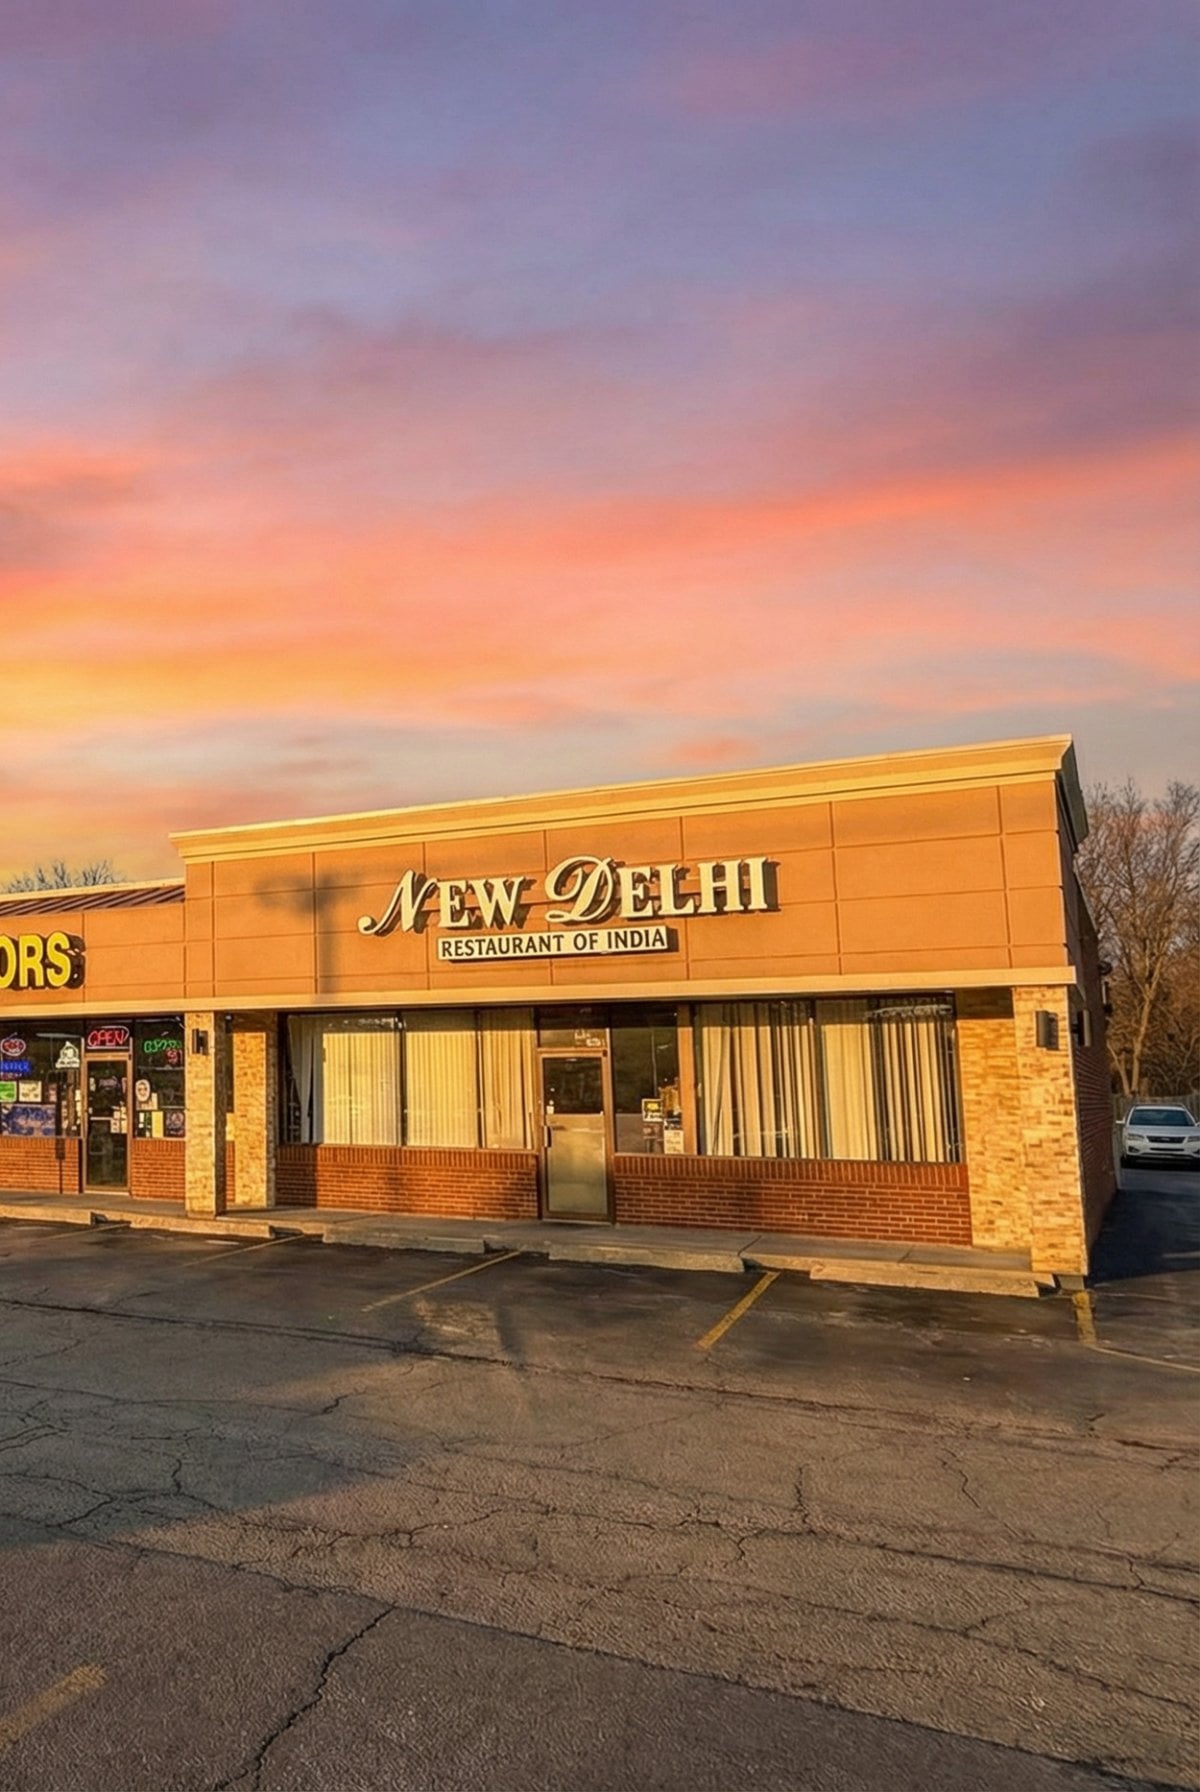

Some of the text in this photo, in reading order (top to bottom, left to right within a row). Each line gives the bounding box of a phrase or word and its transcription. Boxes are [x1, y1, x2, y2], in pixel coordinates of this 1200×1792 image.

[357, 855, 769, 935] NEW DELHI
[441, 928, 667, 958] RESTAURANT OF INDIA
